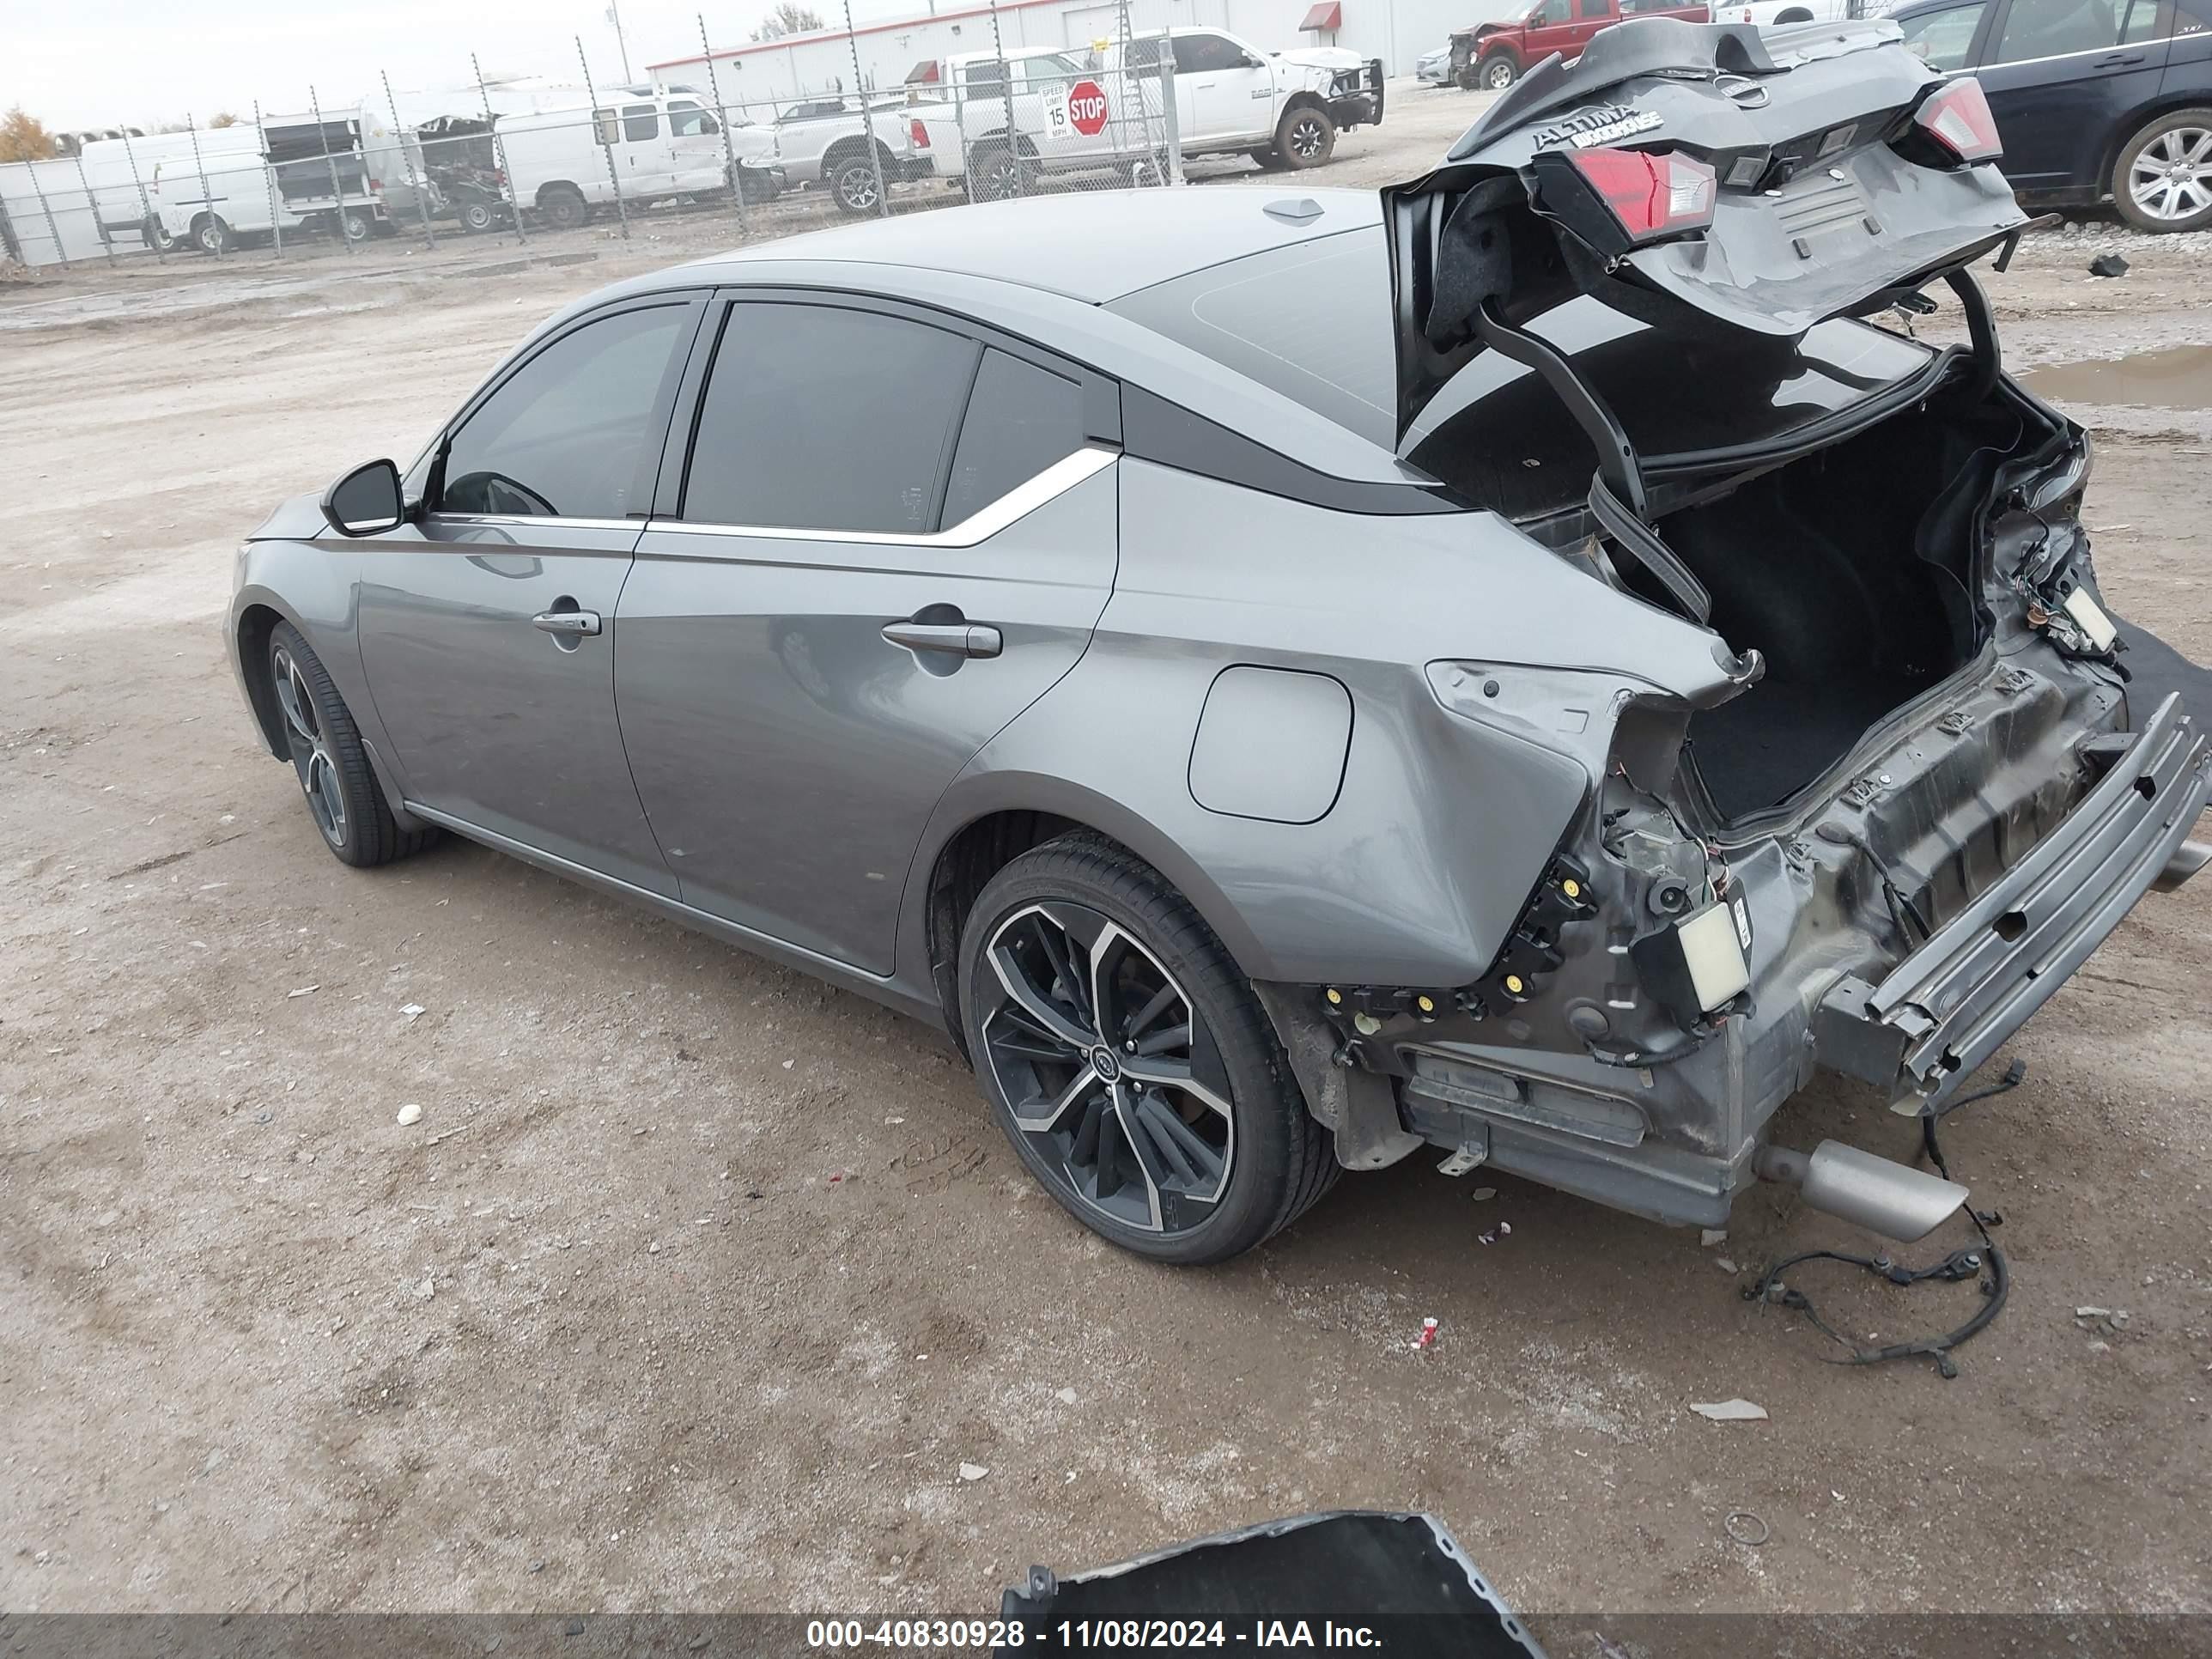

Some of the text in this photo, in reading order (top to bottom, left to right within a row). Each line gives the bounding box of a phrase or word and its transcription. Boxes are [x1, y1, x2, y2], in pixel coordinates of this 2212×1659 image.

[1042, 86, 1064, 97] SPEED
[1045, 95, 1063, 107] LIMIT
[1049, 107, 1065, 126] 15
[1071, 96, 1105, 121] STOP
[1052, 128, 1067, 137] MPH
[1533, 104, 1640, 151] ALTIMA
[1569, 110, 1665, 149] WOODHOUSE
